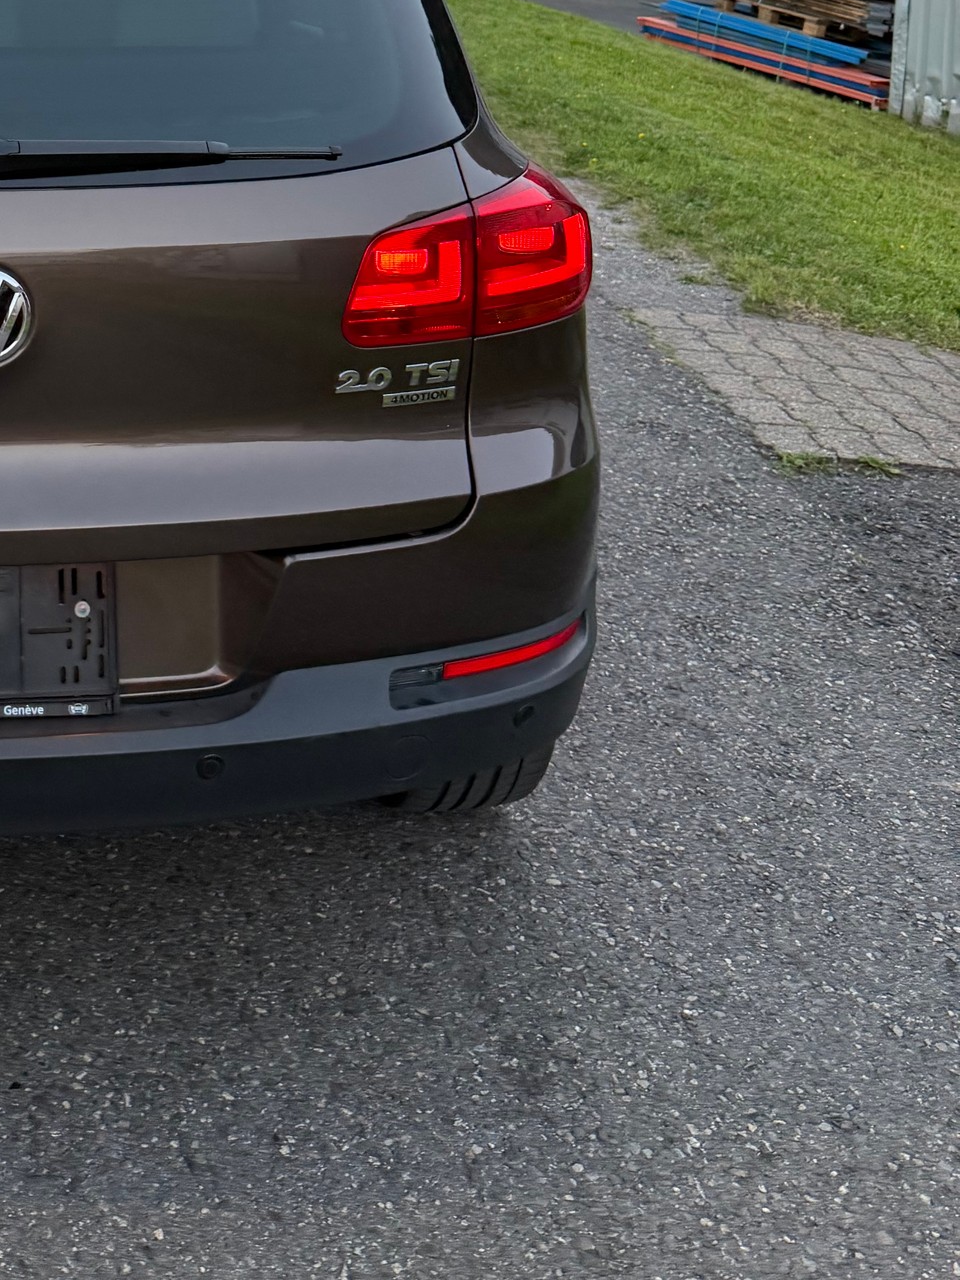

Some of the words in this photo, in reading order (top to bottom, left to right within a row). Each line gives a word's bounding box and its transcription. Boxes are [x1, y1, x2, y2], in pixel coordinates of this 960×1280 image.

[335, 366, 393, 394] 2.0
[405, 358, 460, 386] TSI
[390, 389, 449, 404] 4MOTION
[3, 704, 44, 716] Genève
